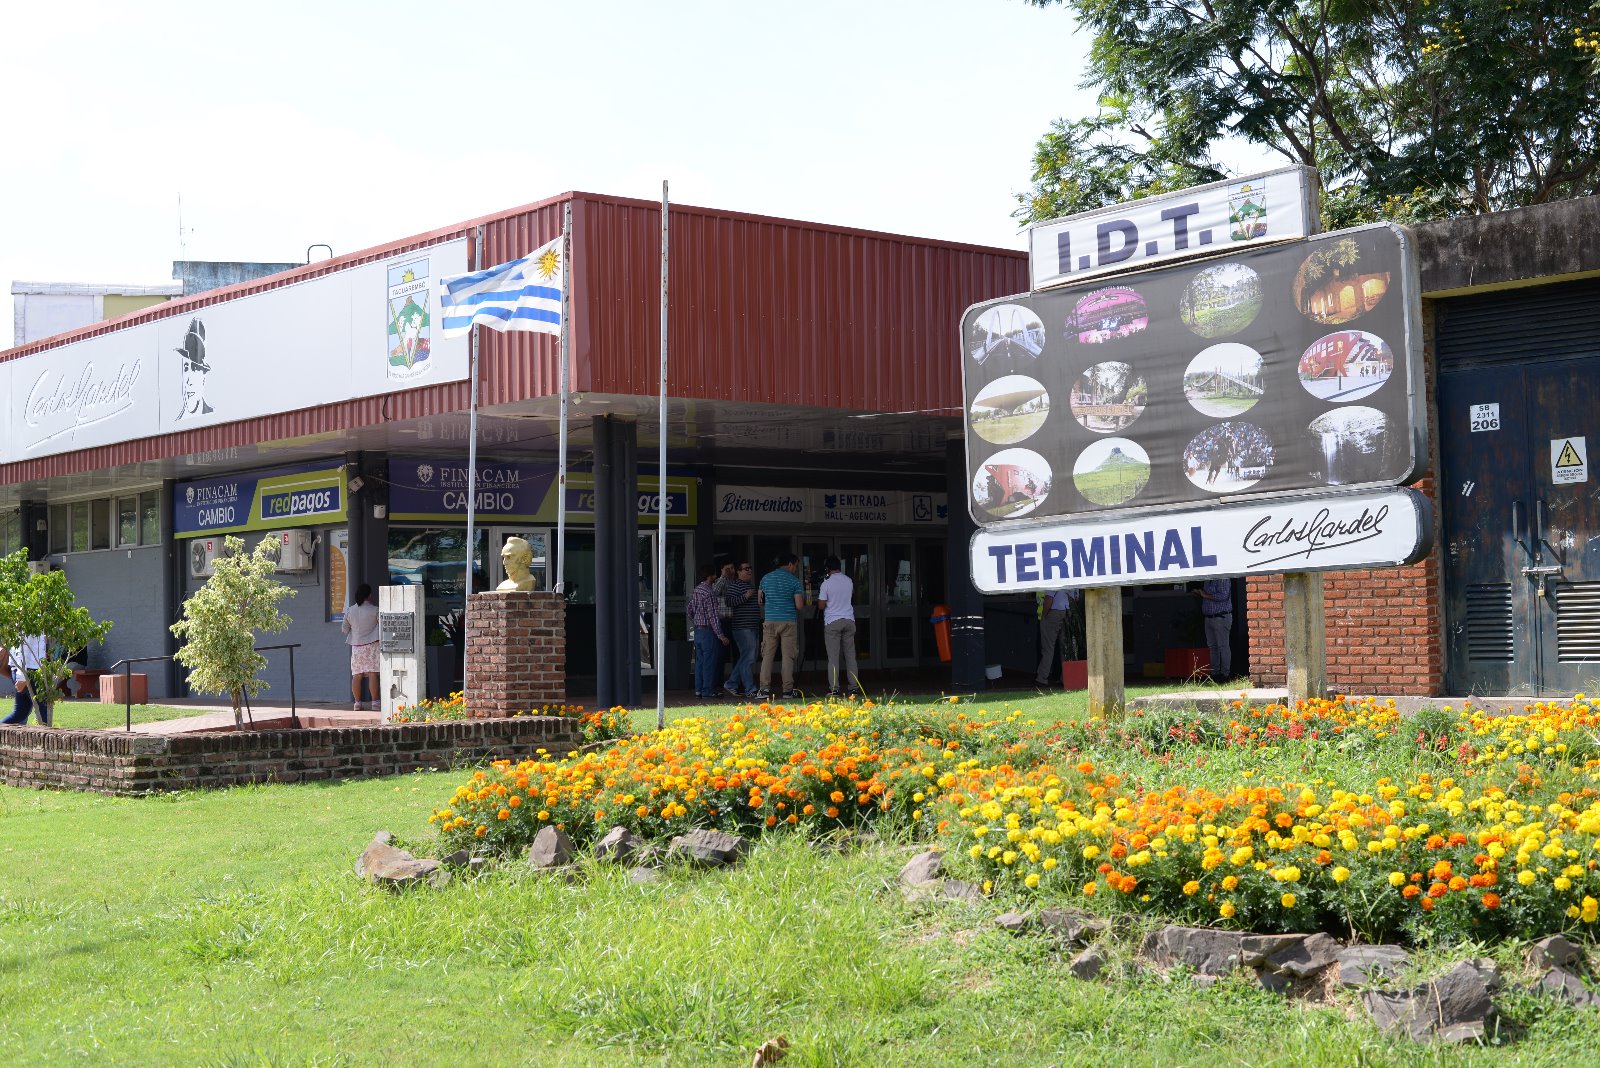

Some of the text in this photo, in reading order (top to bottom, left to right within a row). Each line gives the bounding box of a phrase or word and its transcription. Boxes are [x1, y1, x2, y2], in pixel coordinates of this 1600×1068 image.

[1058, 203, 1212, 274] I.D.T.
[1476, 411, 1495, 419] 2311
[1472, 418, 1499, 431] 206
[440, 467, 520, 483] FINACAM
[196, 483, 238, 500] FINACAM
[839, 494, 887, 507] ENTRADA
[269, 490, 331, 515] redpagos
[443, 492, 514, 510] CAMBIO
[719, 492, 803, 513] Bienvenidos
[198, 506, 235, 526] CAMBIO
[988, 525, 1218, 584] TERMINAL
